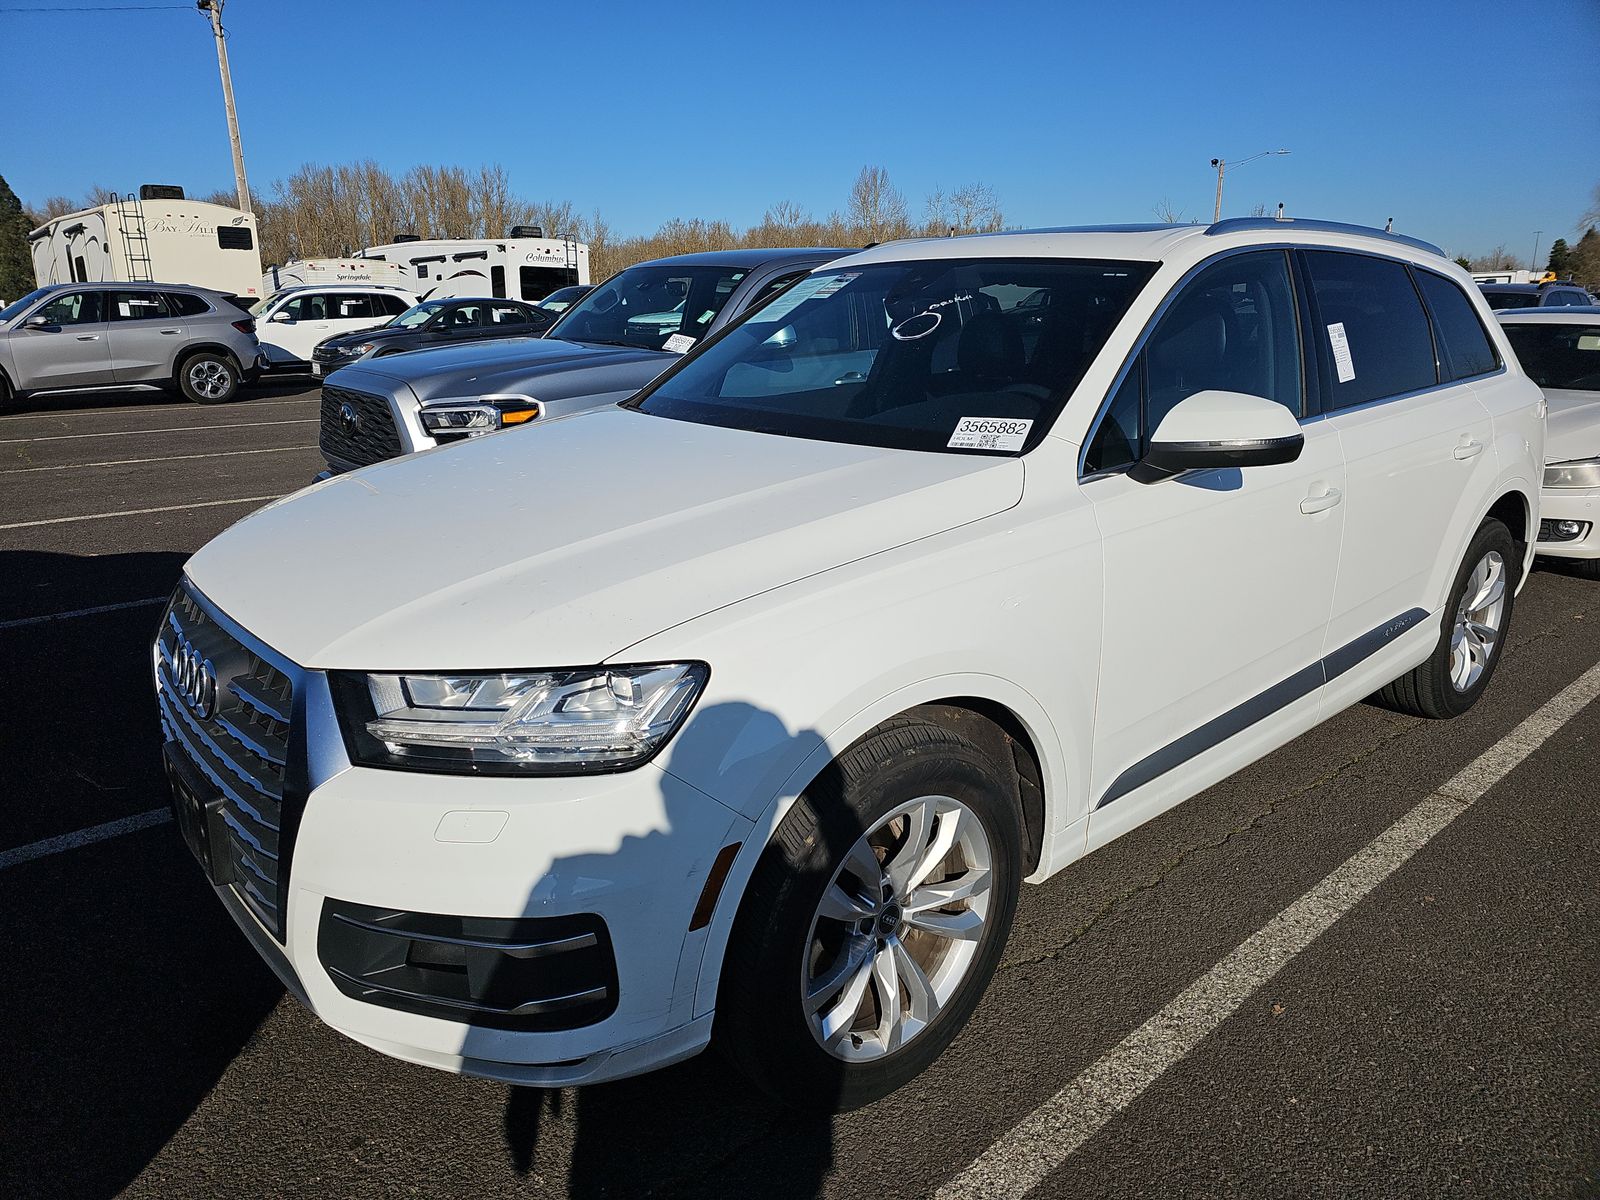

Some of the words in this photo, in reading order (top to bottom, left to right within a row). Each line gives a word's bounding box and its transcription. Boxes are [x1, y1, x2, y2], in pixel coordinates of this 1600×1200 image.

[144, 218, 177, 232] BAY
[181, 219, 217, 234] HILL
[525, 252, 565, 264] Columbus
[336, 273, 371, 281] Springdale
[960, 420, 1027, 435] 3565882
